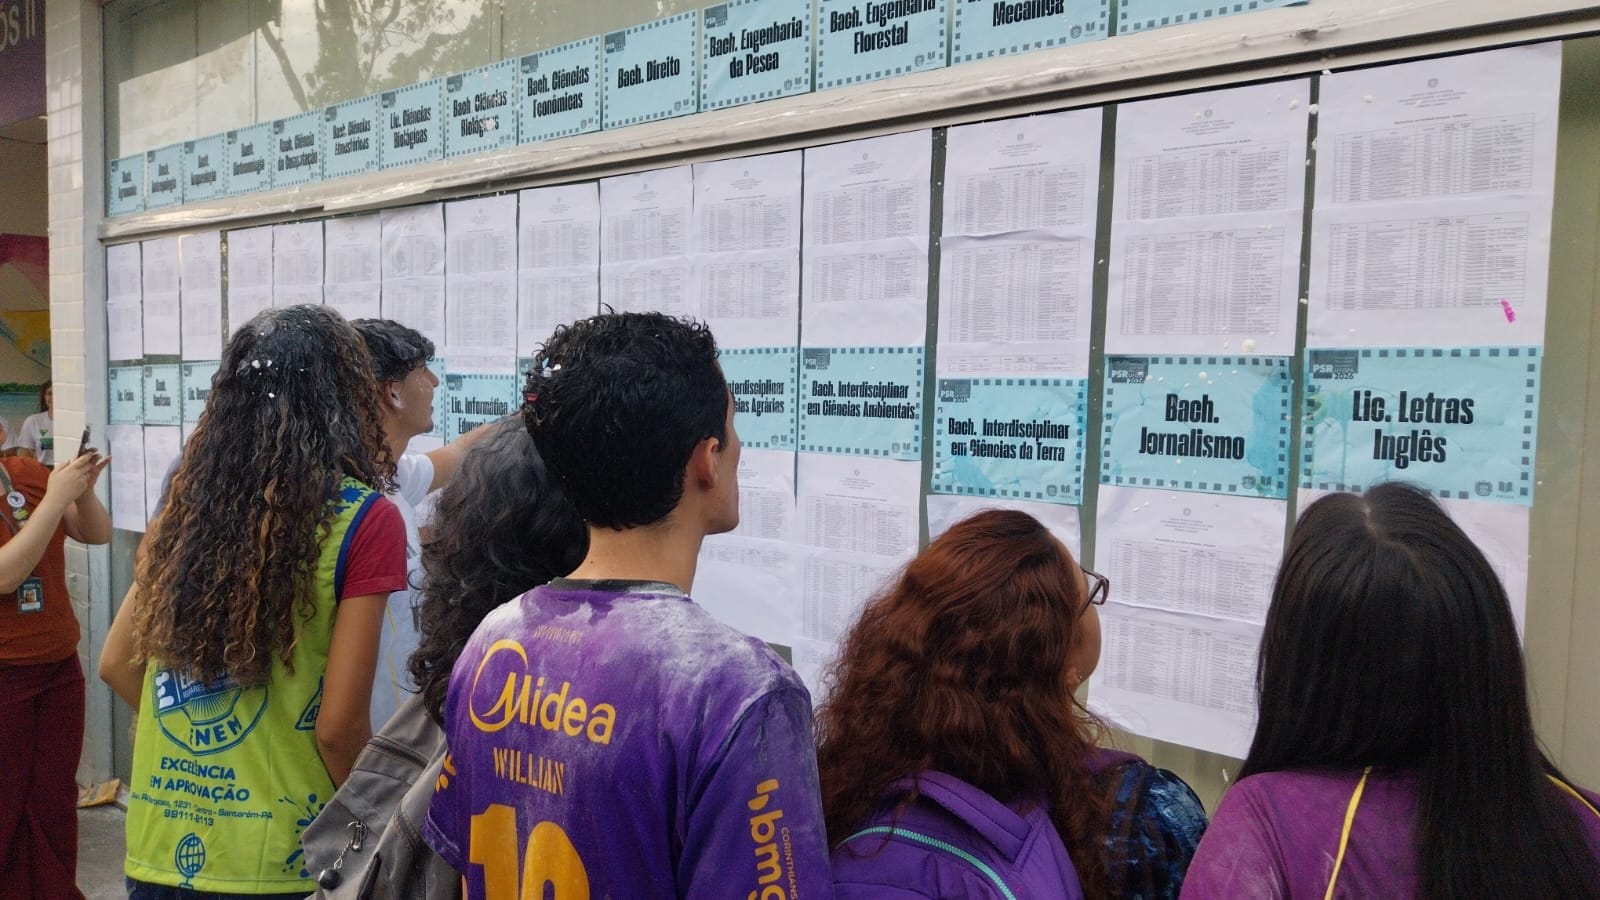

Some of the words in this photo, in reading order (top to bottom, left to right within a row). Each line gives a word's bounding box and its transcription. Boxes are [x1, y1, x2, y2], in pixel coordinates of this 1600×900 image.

[830, 6, 863, 33] Bach.
[709, 32, 738, 58] Bach.
[741, 17, 802, 53] Engenharia
[854, 21, 908, 54] Florestal
[617, 64, 644, 88] Bach.
[646, 56, 680, 82] Direito
[729, 57, 744, 79] da
[746, 52, 779, 76] Pesca
[528, 73, 550, 97] Bach.
[552, 65, 590, 91] Ciências
[1313, 364, 1333, 373] PSR
[727, 379, 784, 397] nterdisciplinar
[811, 380, 836, 397] Bach.
[838, 380, 909, 401] Interdisciplinar
[451, 396, 464, 414] Lic.
[465, 396, 508, 416] Informática
[751, 397, 785, 417] Agrárias
[807, 404, 820, 416] em
[822, 400, 861, 417] Ciências
[863, 401, 915, 419] Ambientais
[1165, 393, 1219, 423] Bach.
[1352, 390, 1392, 422] Lic.
[1398, 391, 1474, 425] Letras
[948, 417, 977, 436] Bach.
[982, 418, 1070, 442] Interdisciplinar
[1138, 426, 1245, 460] Jornalismo
[951, 441, 967, 456] em
[970, 439, 1017, 459] Ciências
[1019, 441, 1032, 460] da
[1036, 442, 1065, 461] Terra
[1373, 429, 1447, 469] Inglês
[470, 639, 617, 745] Midea
[190, 714, 242, 747] NEM
[493, 746, 564, 798] WILLIAN
[151, 775, 162, 789] M
[165, 778, 250, 804] APROVAÇÃO
[781, 827, 799, 900] CORINTHIANS
